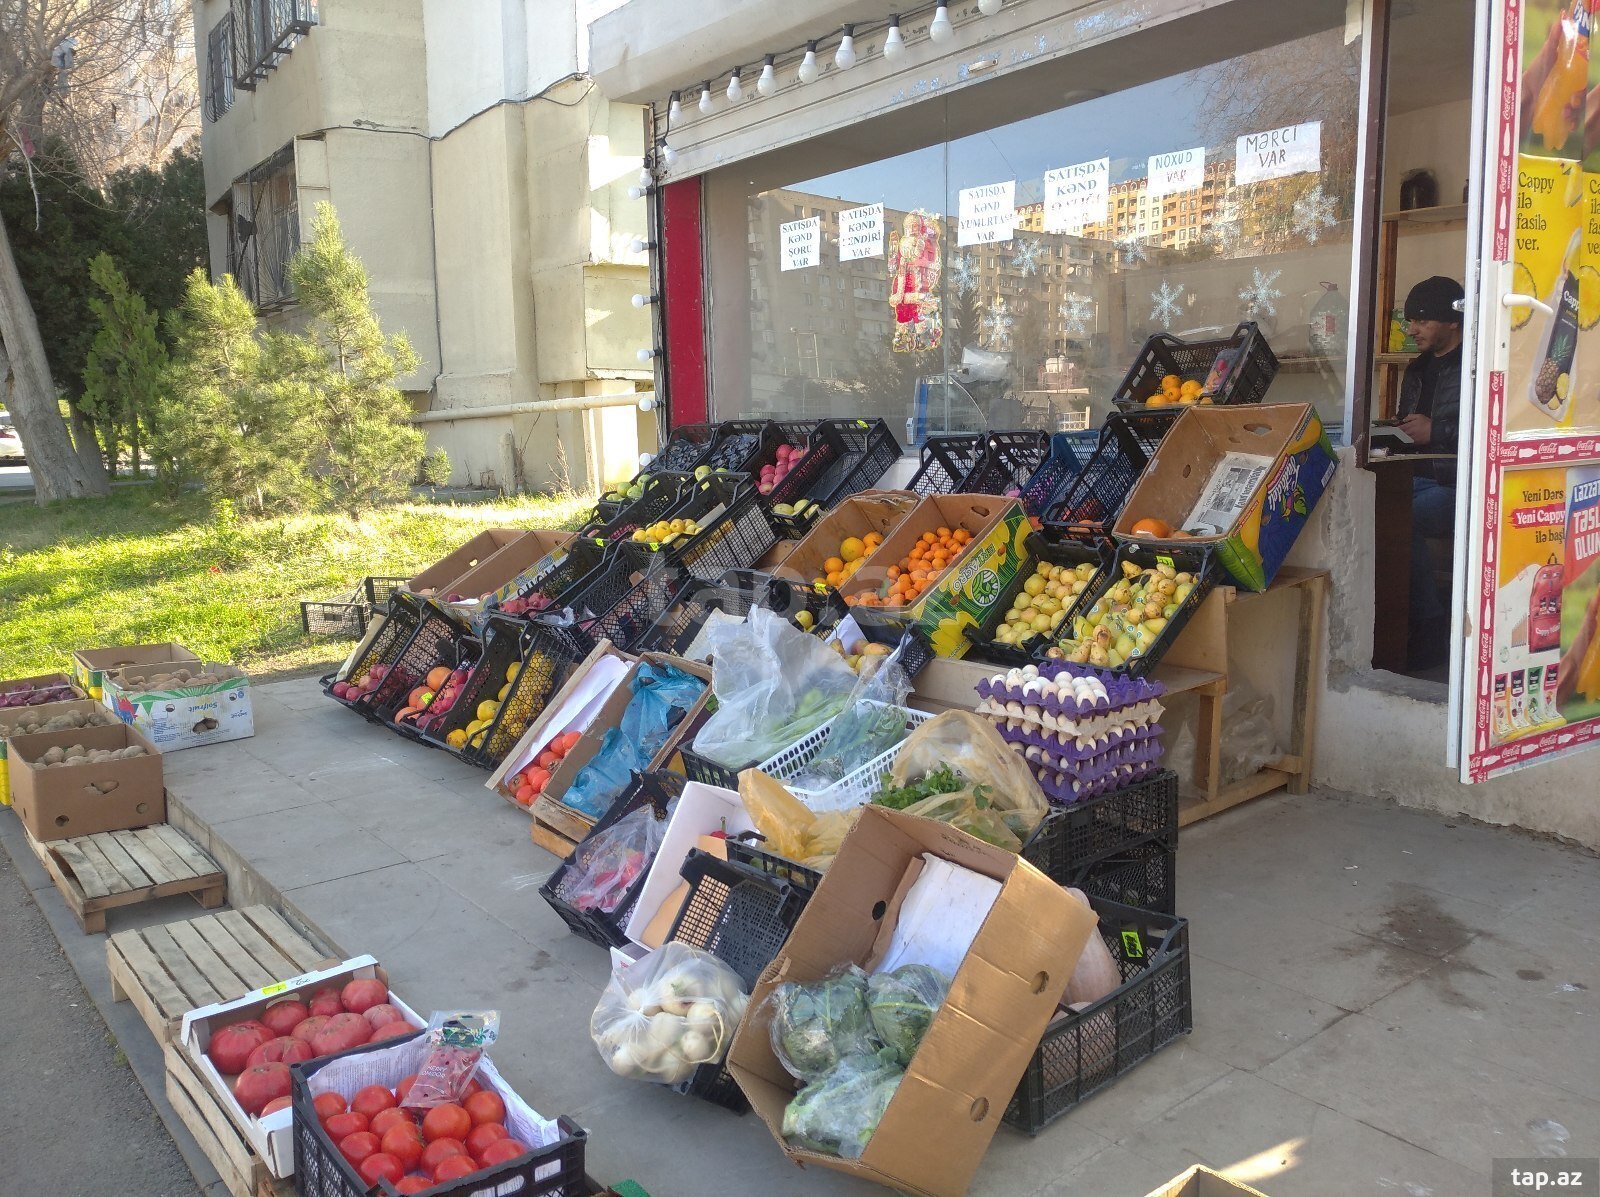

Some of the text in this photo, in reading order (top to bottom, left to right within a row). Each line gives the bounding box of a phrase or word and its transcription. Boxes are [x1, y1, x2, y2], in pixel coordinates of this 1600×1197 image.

[1156, 152, 1193, 170] NOXUD
[1259, 149, 1286, 167] VAR
[1057, 180, 1097, 195] KƏND
[1518, 172, 1554, 194] Cappy
[974, 202, 1000, 213] KƏND
[1518, 193, 1532, 209] ilə
[848, 220, 876, 232] KƏND
[1516, 213, 1547, 231] fasilə
[788, 233, 813, 244] KƏND
[977, 231, 995, 241] VAR
[1516, 237, 1540, 251] ver.
[852, 247, 871, 257] VAR
[793, 257, 809, 267] VAR
[1522, 489, 1541, 502] Yeni
[1516, 510, 1536, 525] Yeni
[1537, 510, 1566, 524] Cappy
